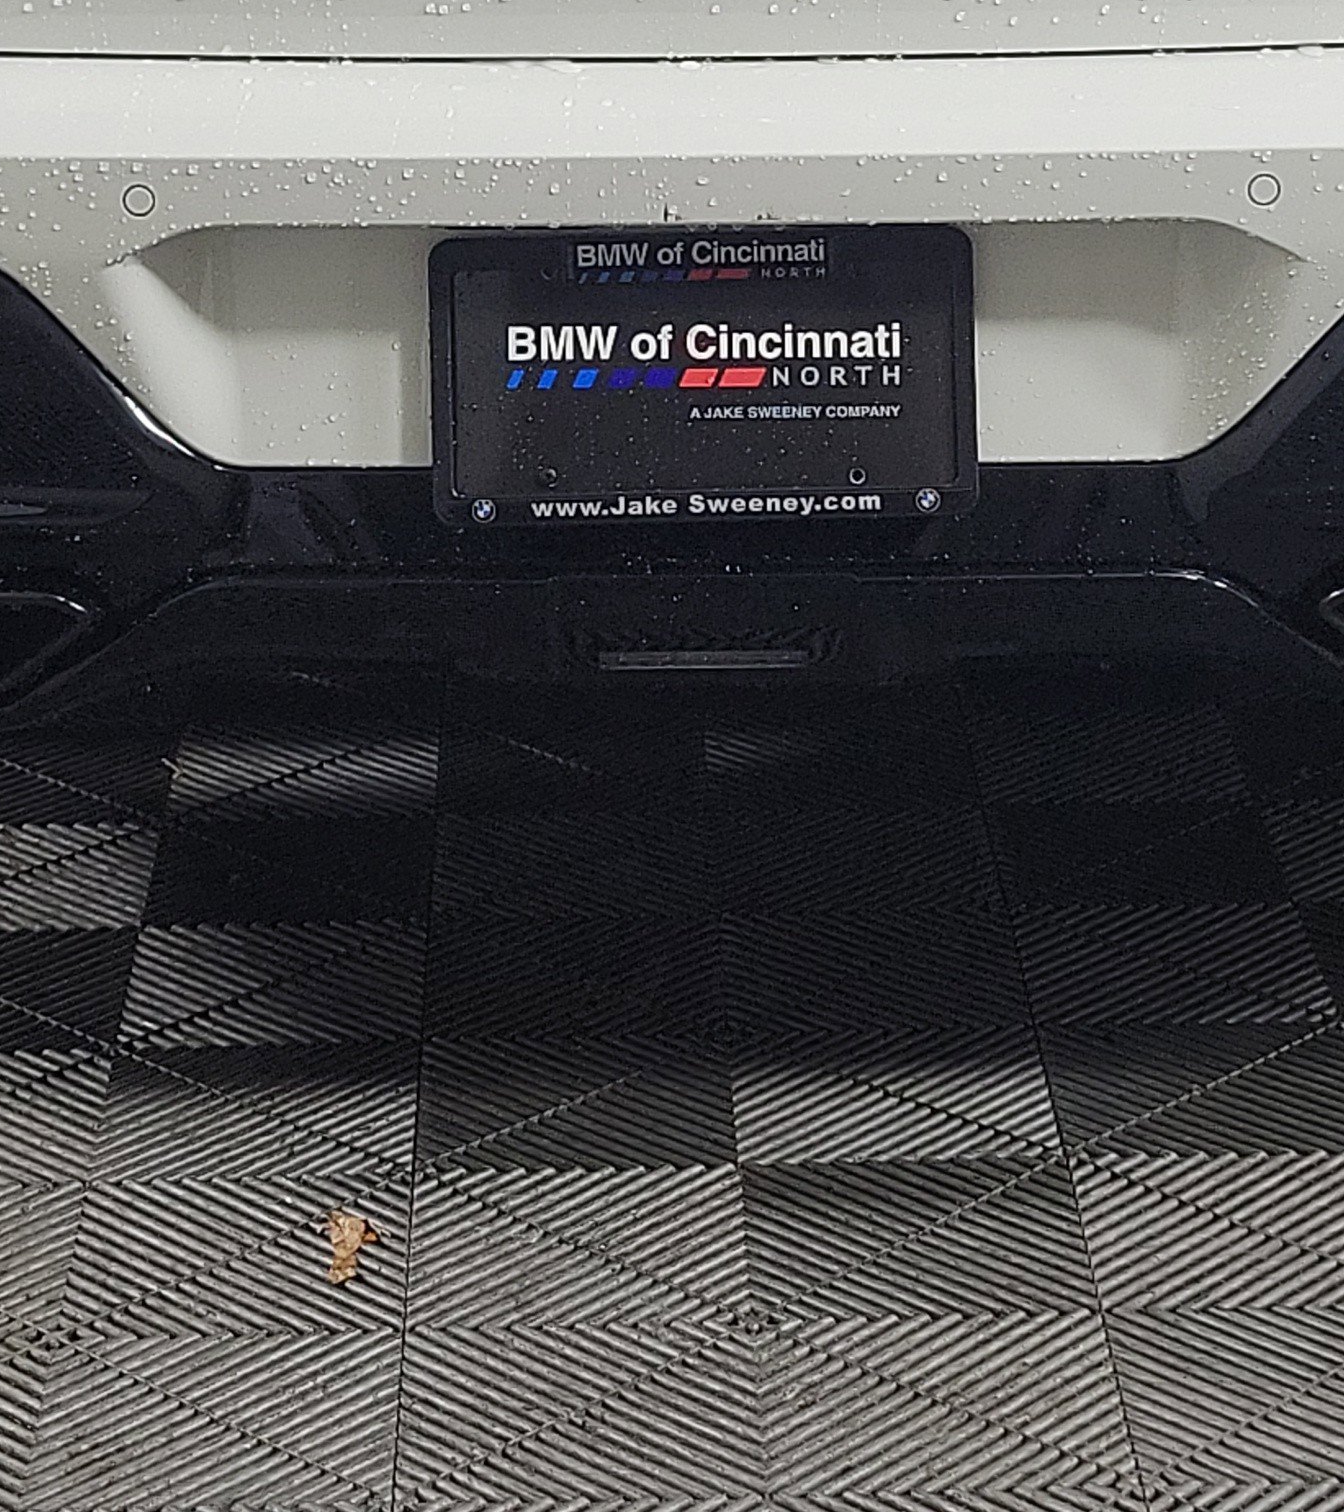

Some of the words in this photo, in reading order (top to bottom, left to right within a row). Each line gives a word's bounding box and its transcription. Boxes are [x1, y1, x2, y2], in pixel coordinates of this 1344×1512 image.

[576, 242, 649, 267] BMW
[657, 241, 686, 265] of
[690, 238, 826, 265] Cincinnati
[761, 266, 827, 279] NORTH
[506, 325, 617, 362] BMW
[630, 323, 674, 361] of
[685, 321, 902, 360] Cincinnati
[771, 365, 903, 387] NORTH
[689, 406, 701, 419] A
[703, 405, 745, 419] JAKE
[747, 405, 823, 419] SWEENEY
[824, 404, 901, 419] COMPANY
[530, 495, 679, 518] www.Jake
[688, 492, 882, 514] Sweeney.com
